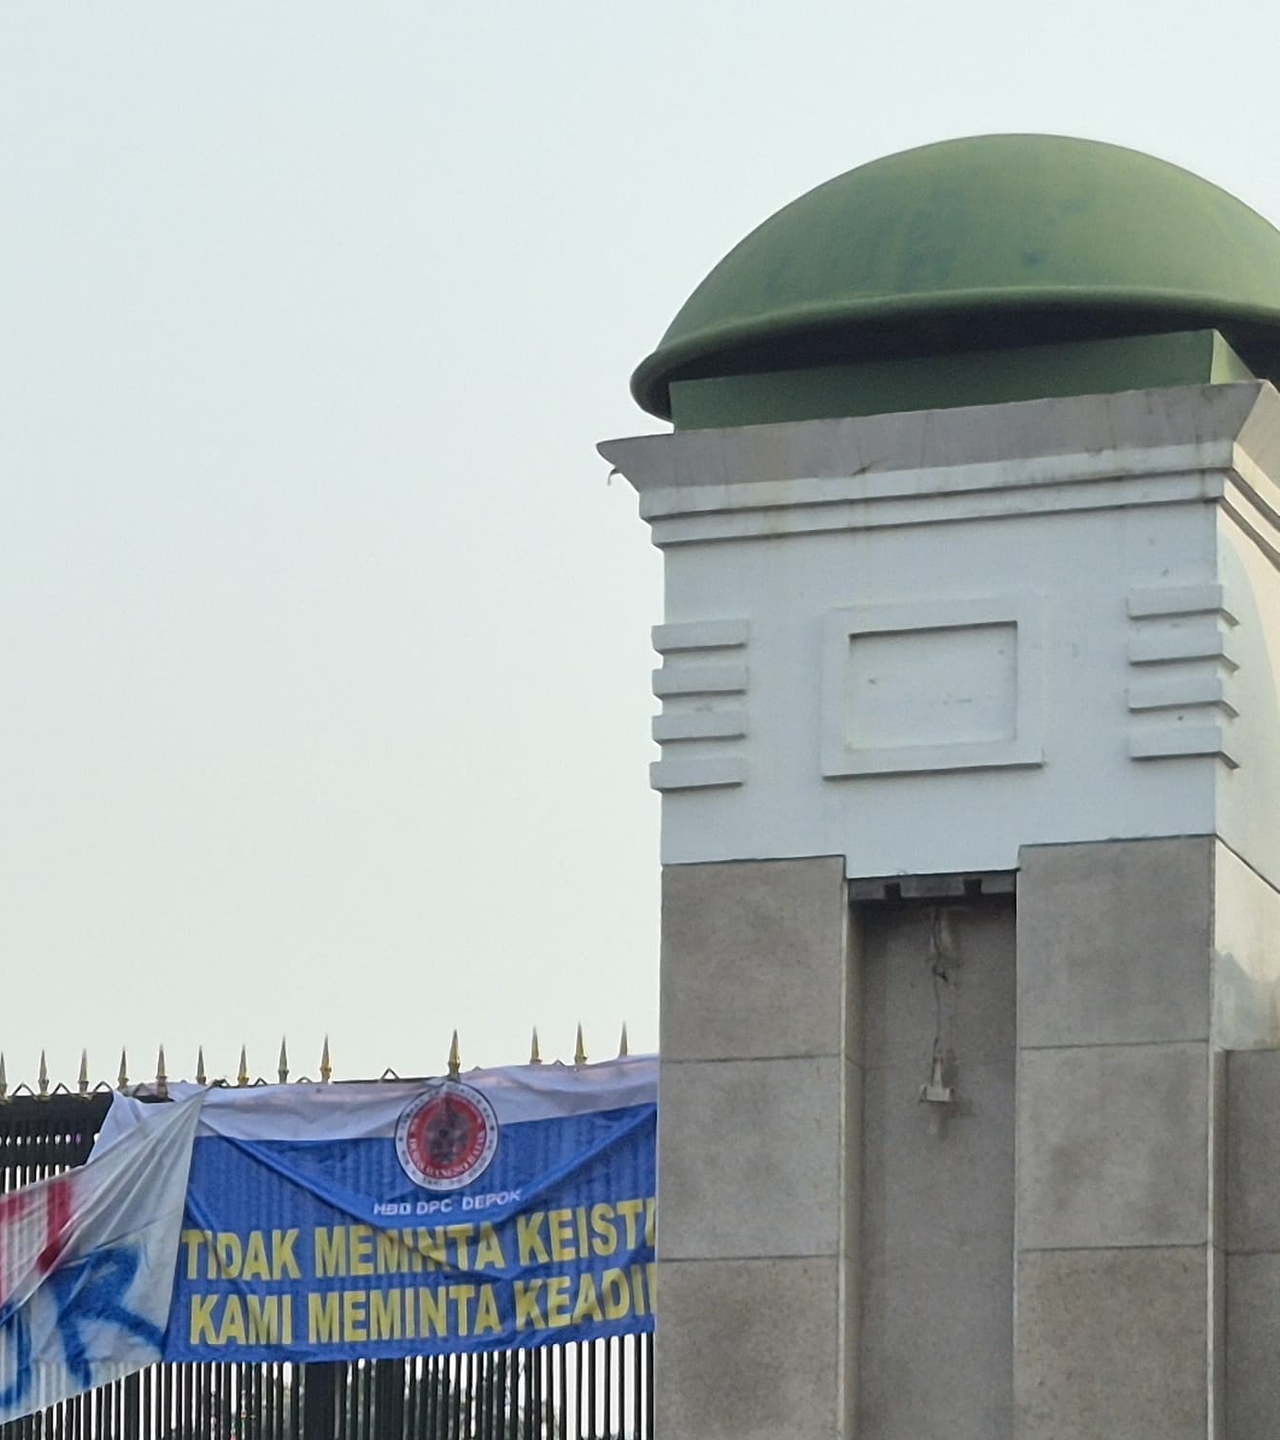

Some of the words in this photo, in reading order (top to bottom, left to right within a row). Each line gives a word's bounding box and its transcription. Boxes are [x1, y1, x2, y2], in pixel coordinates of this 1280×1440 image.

[416, 1198, 453, 1215] DPC
[462, 1189, 522, 1211] DEPOK
[181, 1228, 301, 1282] TIDAK
[315, 1221, 499, 1280] MEMINTA
[190, 1294, 292, 1346] KAMI
[308, 1284, 503, 1345] MEMINTA
